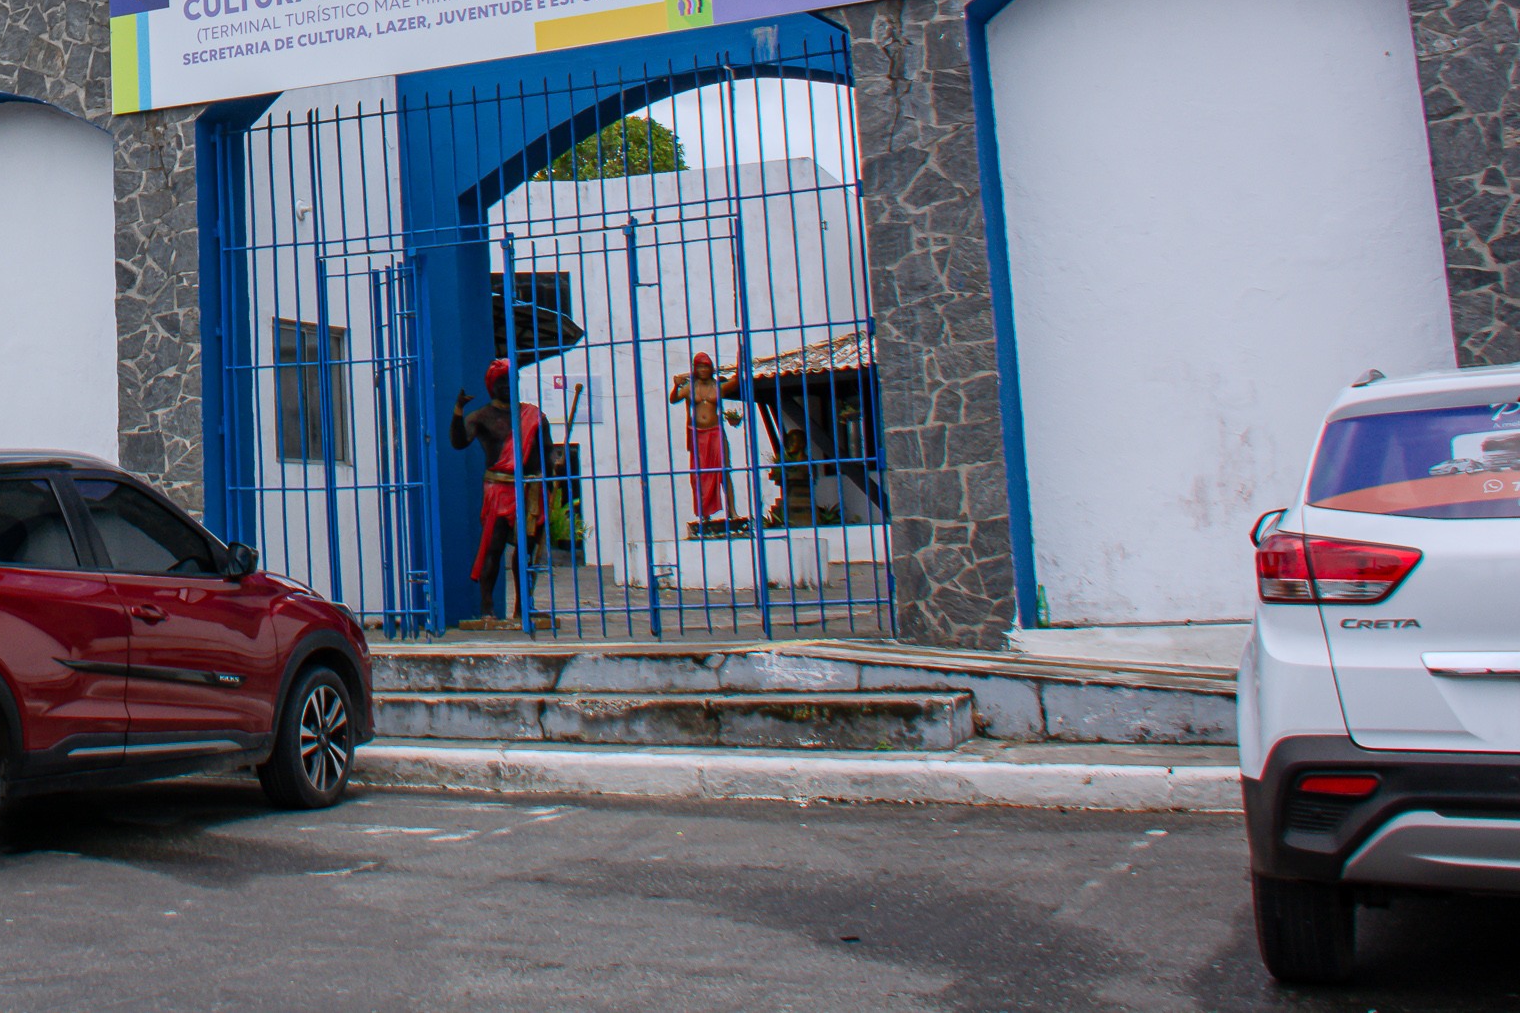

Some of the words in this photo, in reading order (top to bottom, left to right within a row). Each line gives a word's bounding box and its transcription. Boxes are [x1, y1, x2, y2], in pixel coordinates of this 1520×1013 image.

[182, 40, 271, 66] SECRETARIA
[274, 36, 294, 51] DE
[297, 25, 372, 47] CULTURA,
[376, 15, 431, 36] LAZER,
[197, 16, 281, 44] (TERMINAL
[285, 1, 369, 27] TURÍSTICO
[1340, 618, 1421, 630] CRETA
